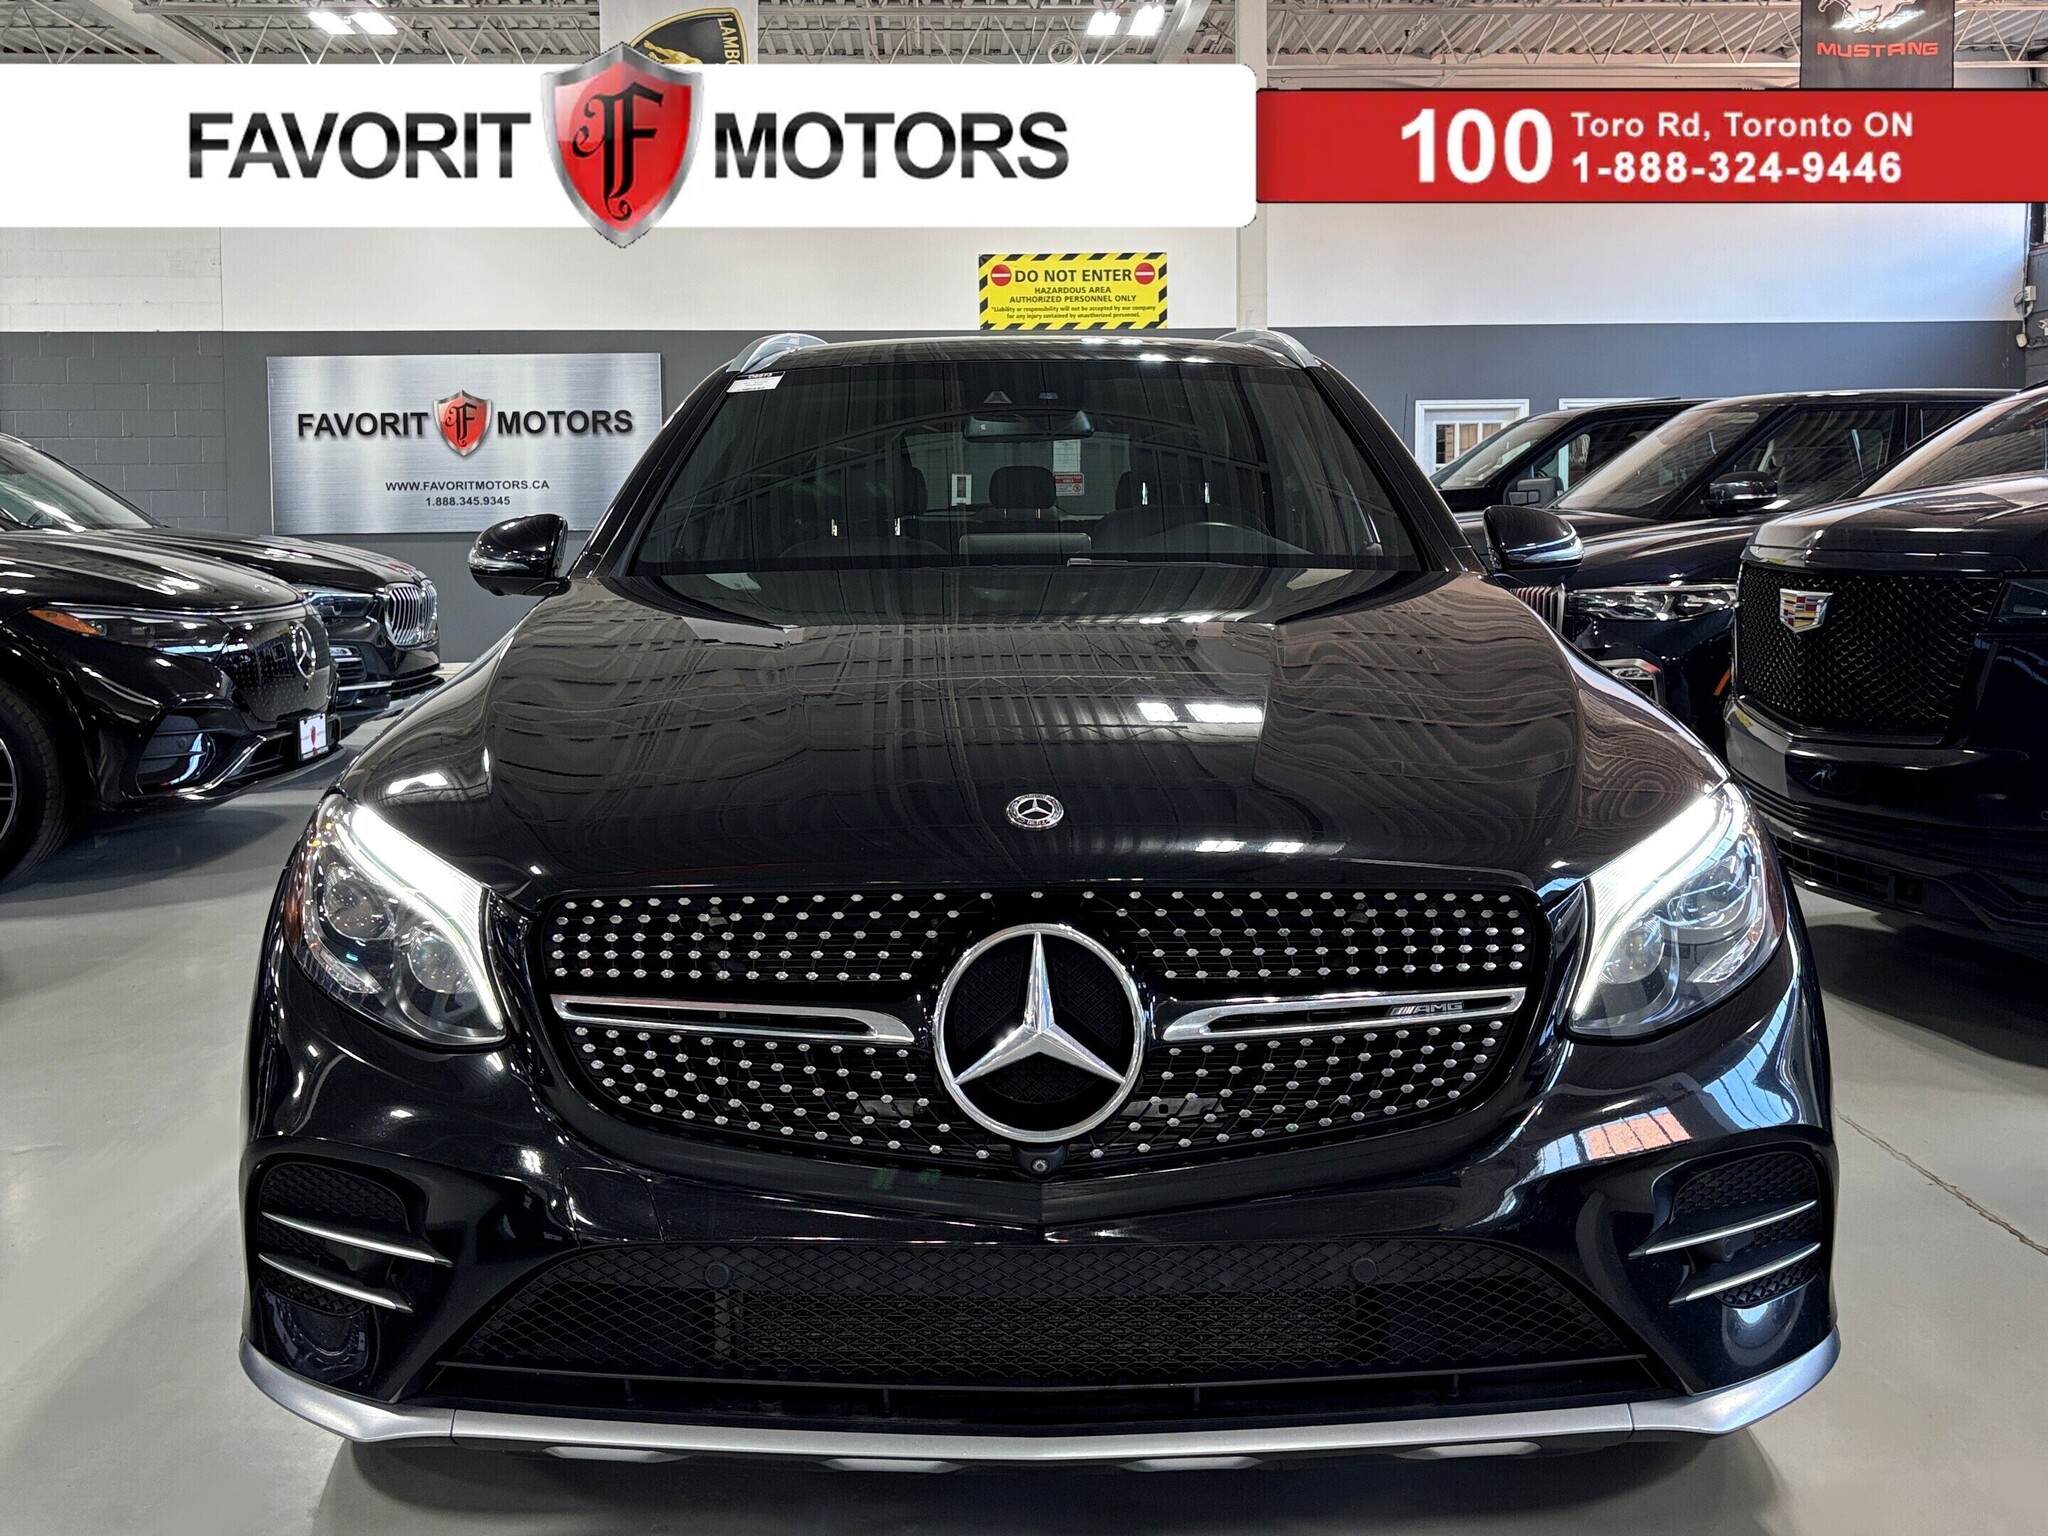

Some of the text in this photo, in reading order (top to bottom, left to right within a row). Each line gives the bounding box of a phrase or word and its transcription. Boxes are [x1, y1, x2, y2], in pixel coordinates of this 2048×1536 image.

[1816, 42, 1939, 58] MUSTANG
[1014, 268, 1132, 283] DO NOT ENTER
[1034, 286, 1086, 294] HAZARDOUS
[1009, 294, 1137, 303] AUTHORIZED PERSONNEL ONLY
[297, 412, 429, 437] FAVORIT
[497, 410, 634, 436] MOTORS
[385, 480, 550, 492] WWW.FAVORITMOTORS.CA
[425, 496, 511, 507] 1.888.345.9345
